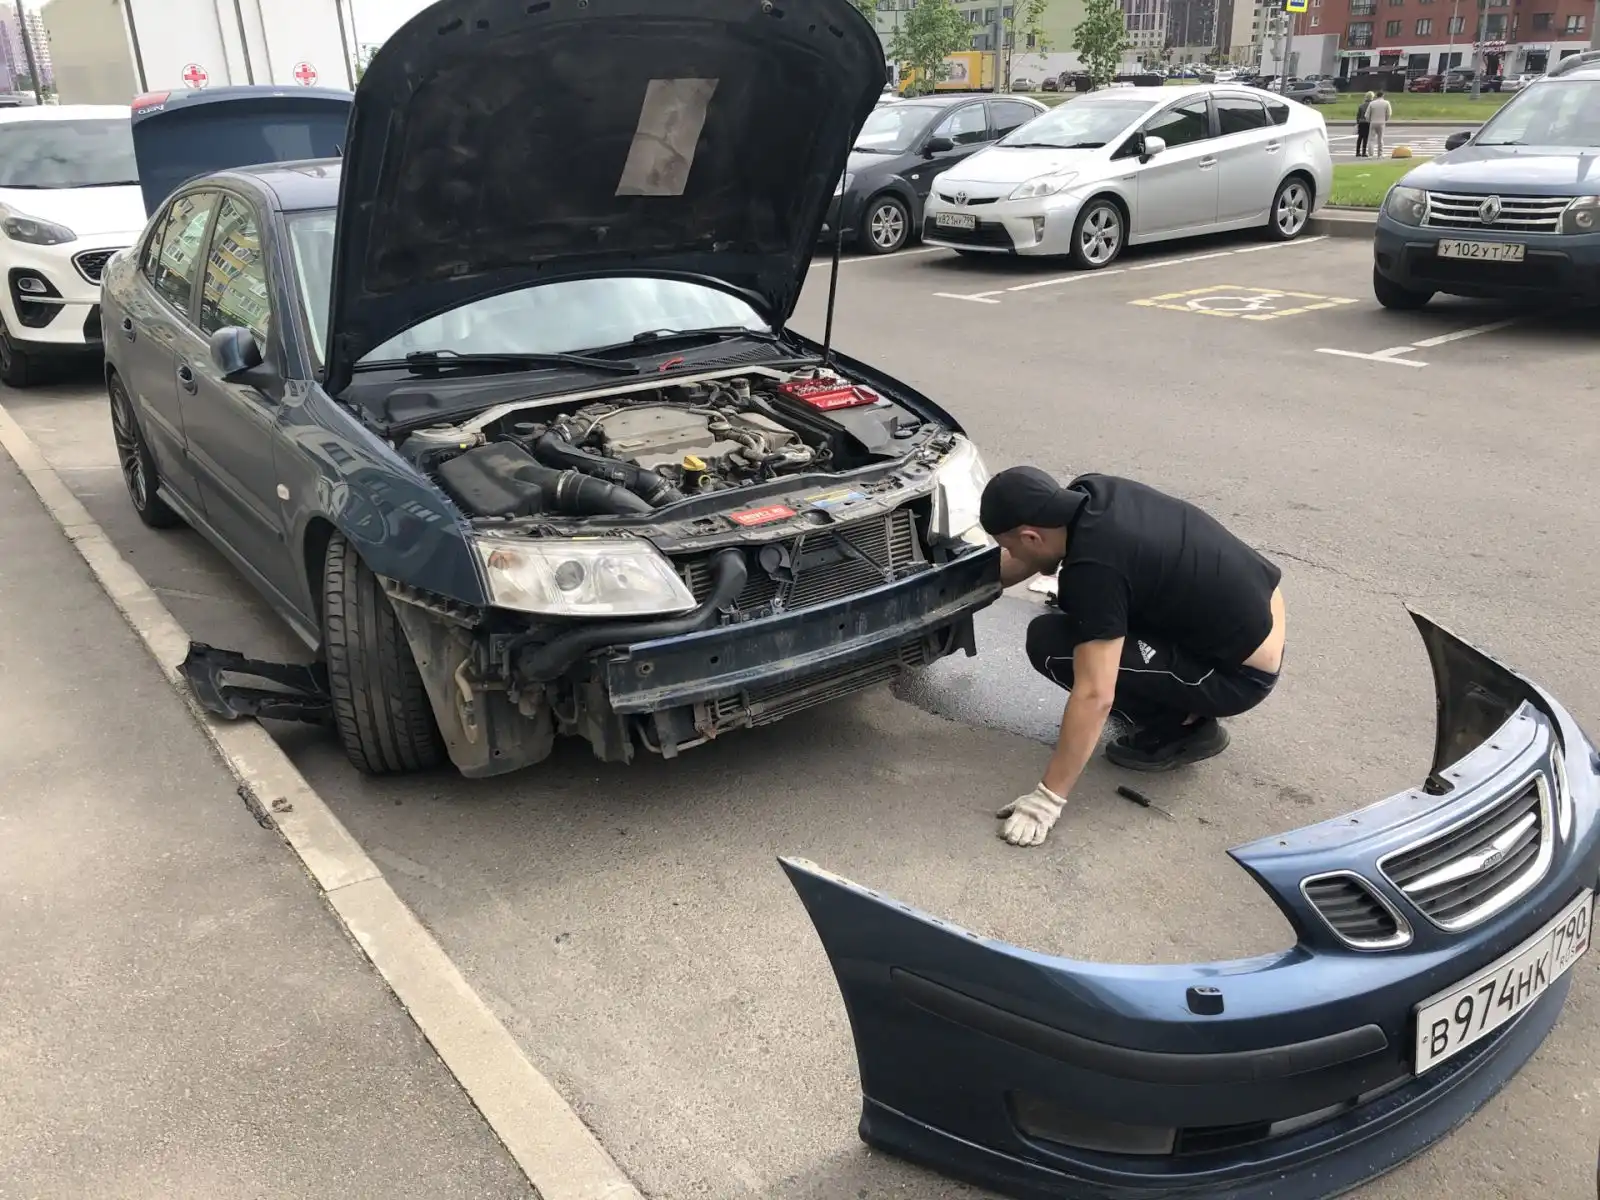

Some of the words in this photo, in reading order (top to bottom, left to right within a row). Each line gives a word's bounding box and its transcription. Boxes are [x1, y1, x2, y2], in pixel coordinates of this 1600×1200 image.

[138, 104, 165, 114] Aero
[1443, 242, 1500, 258] У102УТ
[1504, 244, 1520, 256] 77
[1559, 947, 1576, 968] RUS
[1430, 951, 1549, 1059] В974НК
[1556, 906, 1586, 961] 790
